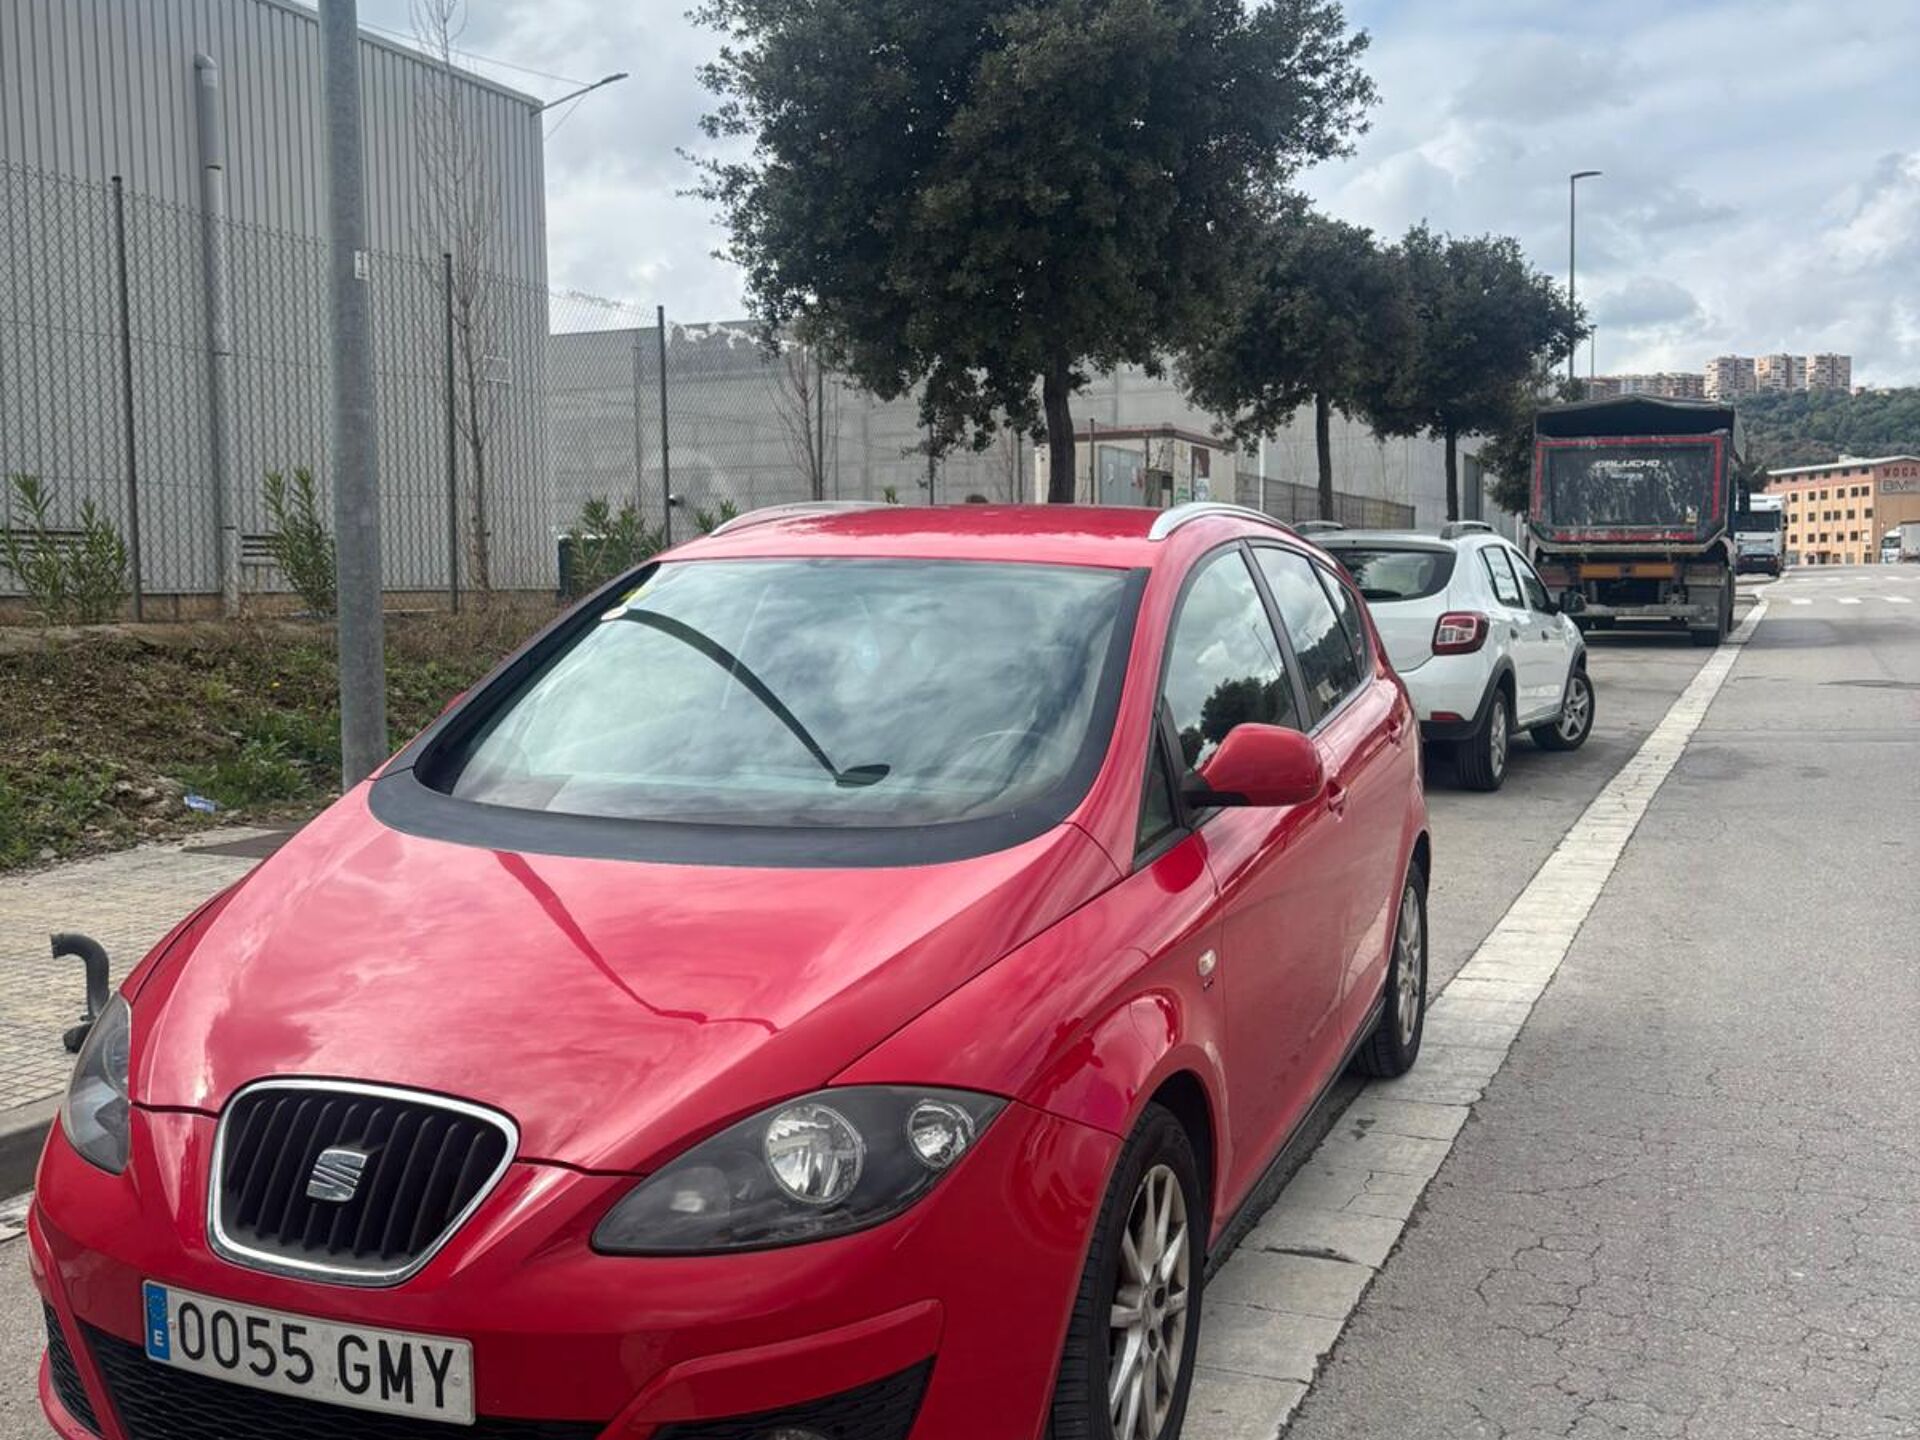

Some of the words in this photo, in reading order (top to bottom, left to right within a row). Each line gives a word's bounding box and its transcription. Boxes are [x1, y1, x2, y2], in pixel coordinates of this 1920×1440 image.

[154, 1330, 165, 1347] E
[178, 1302, 315, 1384] 0055
[337, 1334, 454, 1409] GMY
